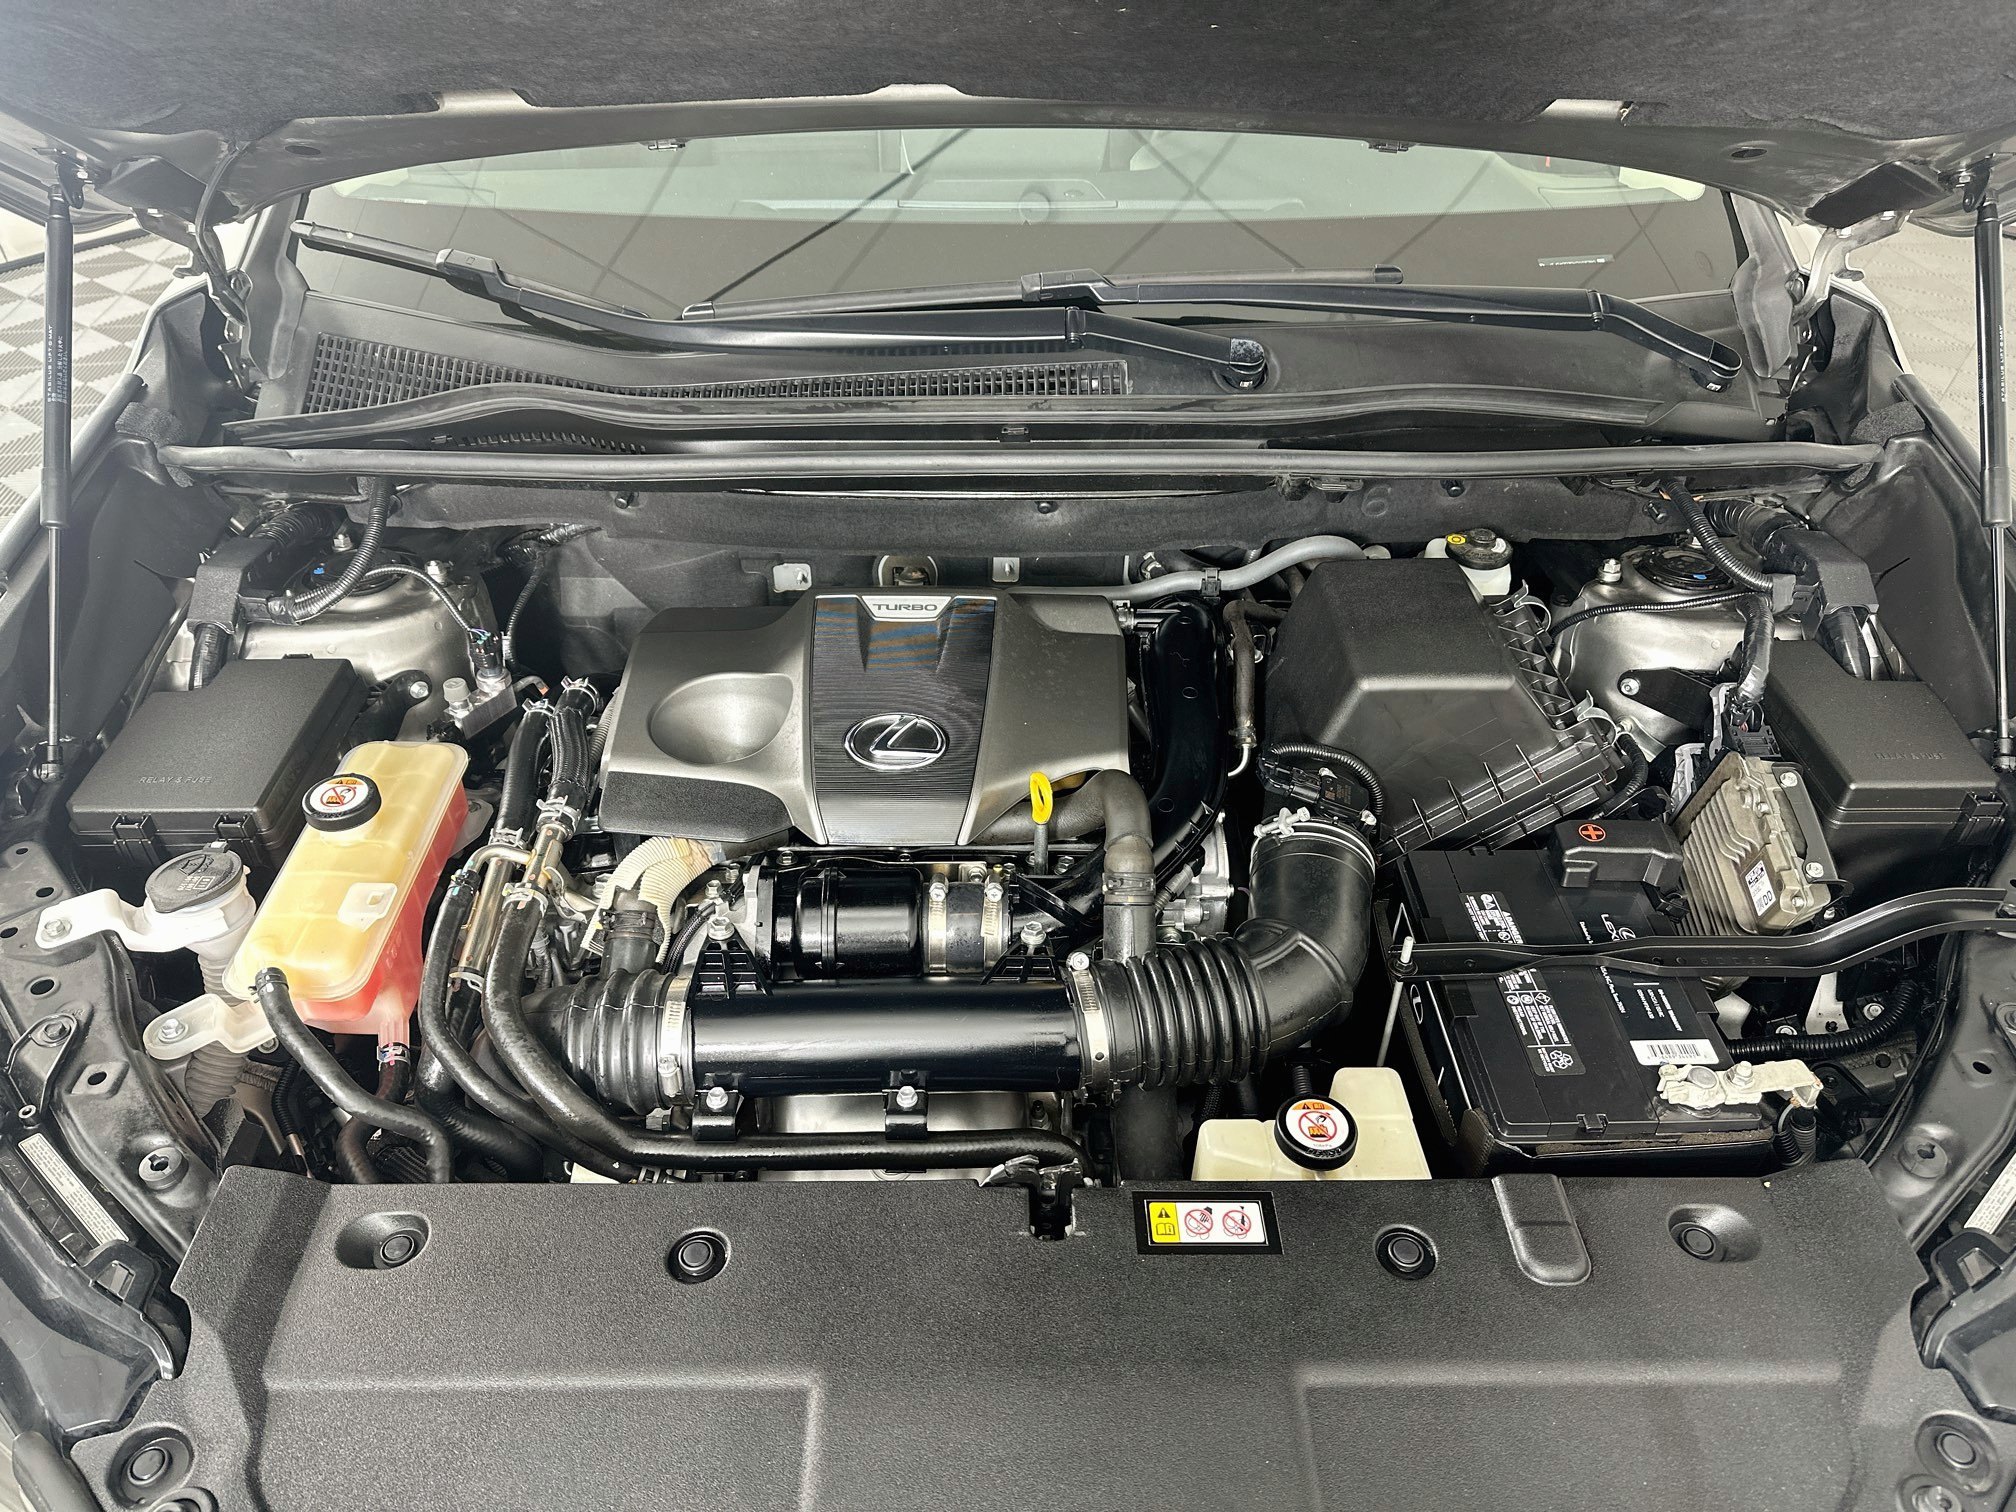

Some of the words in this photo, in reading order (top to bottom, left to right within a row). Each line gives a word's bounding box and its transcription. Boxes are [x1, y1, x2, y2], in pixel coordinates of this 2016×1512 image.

[872, 603, 938, 612] TURBO
[138, 776, 174, 784] RELAY
[174, 776, 183, 784] &
[184, 776, 212, 784] FUSE
[1505, 916, 1524, 944] DANGER
[1601, 914, 1620, 942] LEX
